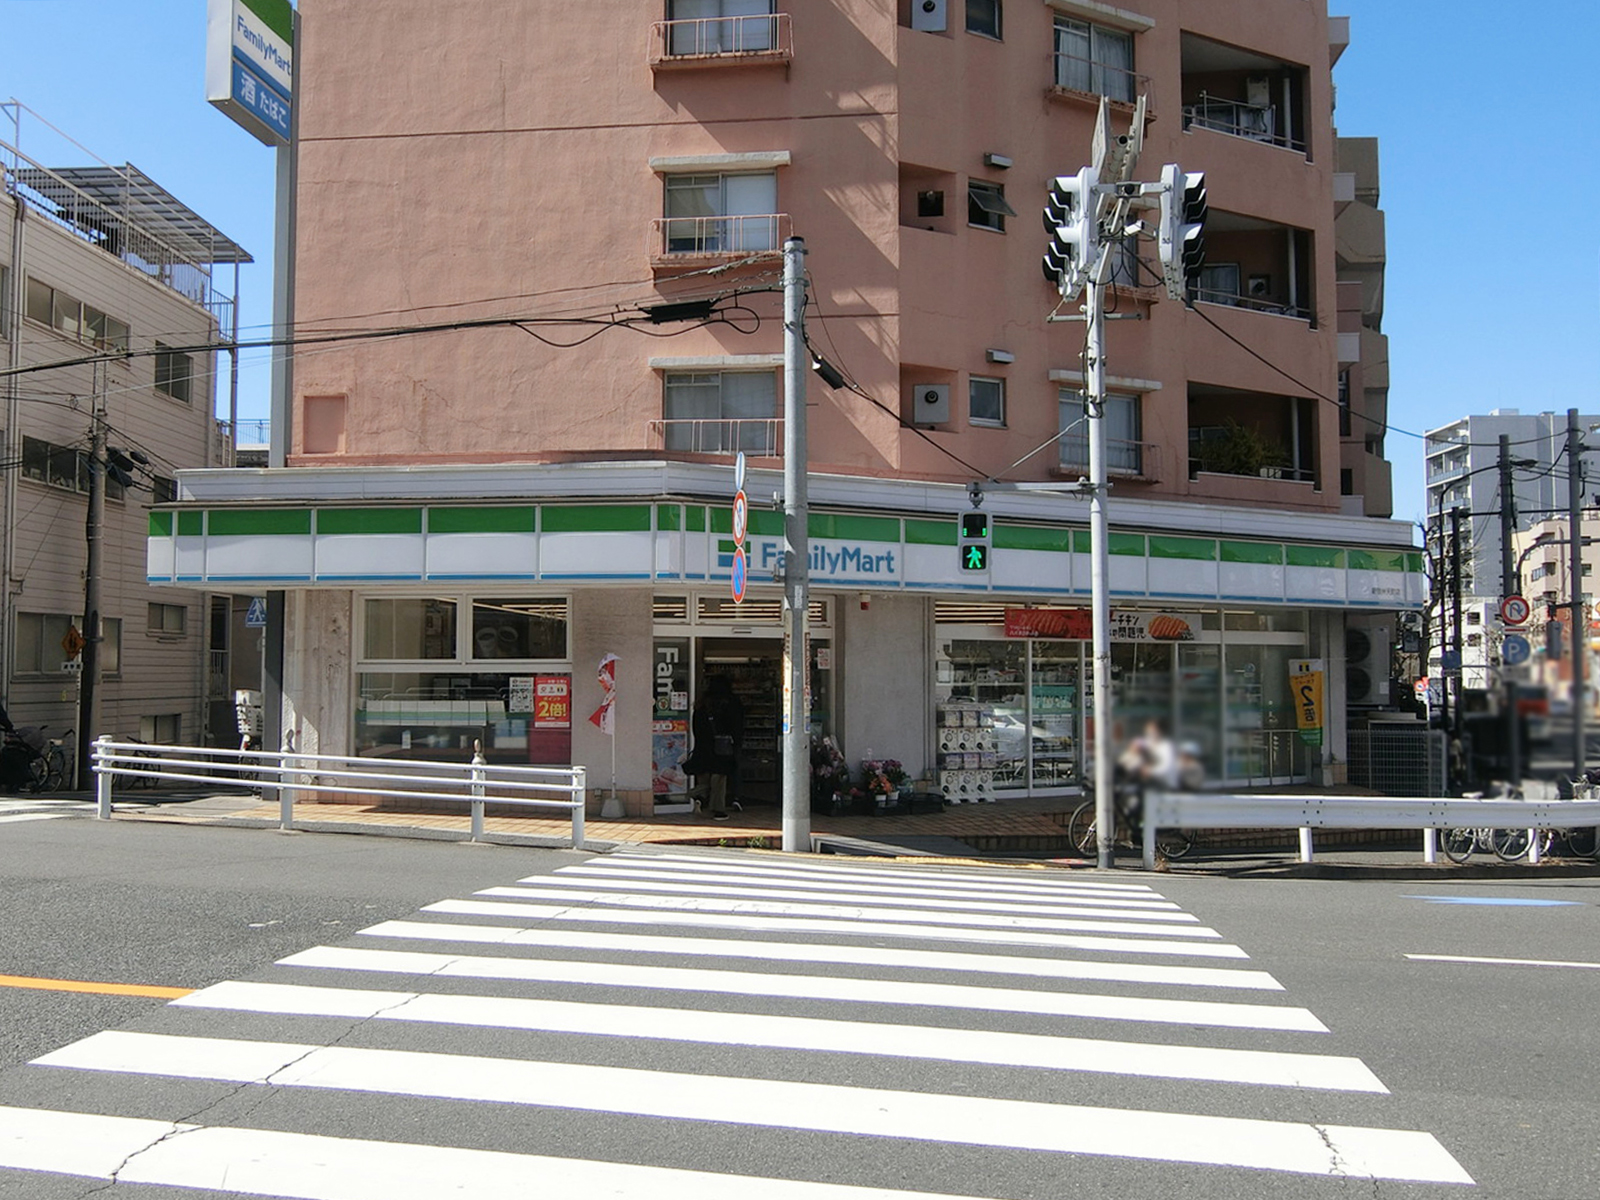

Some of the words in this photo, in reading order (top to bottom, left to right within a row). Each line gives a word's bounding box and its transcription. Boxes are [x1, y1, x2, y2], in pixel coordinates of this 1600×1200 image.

[237, 15, 291, 76] FamilyMart
[240, 71, 256, 107] 酒
[260, 91, 287, 129] たばこ
[762, 543, 894, 574] FailyMart
[1508, 642, 1520, 661] P
